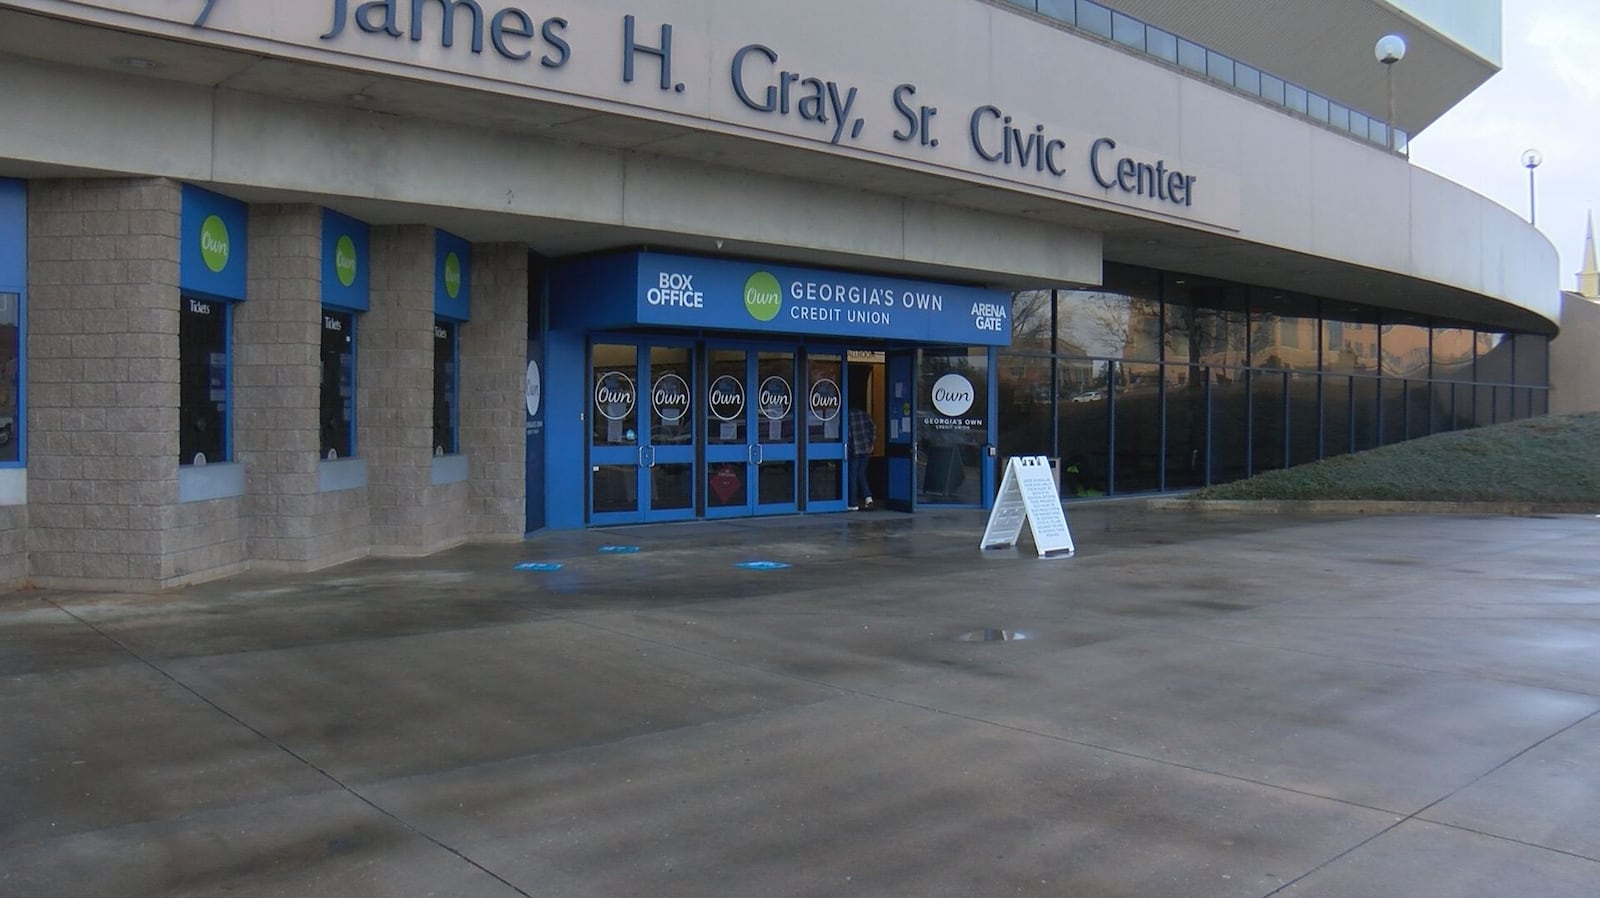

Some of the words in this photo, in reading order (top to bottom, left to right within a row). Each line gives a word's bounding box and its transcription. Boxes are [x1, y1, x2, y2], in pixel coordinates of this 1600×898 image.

[623, 14, 686, 93] H.
[731, 43, 865, 144] Gray,
[893, 83, 939, 147] Sr.
[969, 104, 1066, 176] Civic
[1090, 137, 1196, 206] Center
[201, 231, 228, 256] Own
[659, 272, 693, 291] BOX
[647, 288, 703, 308] OFFICE
[746, 287, 779, 305] Own
[791, 281, 894, 307] GEORGIA'S
[902, 291, 942, 311] OWN
[189, 299, 210, 314] Tickets
[970, 302, 1006, 319] ARENA
[790, 306, 841, 321] CREDIT
[847, 310, 890, 325] UNION
[975, 316, 1002, 331] GATE
[598, 386, 632, 404] Own
[655, 389, 688, 406] Own
[711, 390, 742, 406] Own
[761, 390, 790, 406] Own
[812, 391, 840, 408] Own
[935, 388, 970, 404] Own
